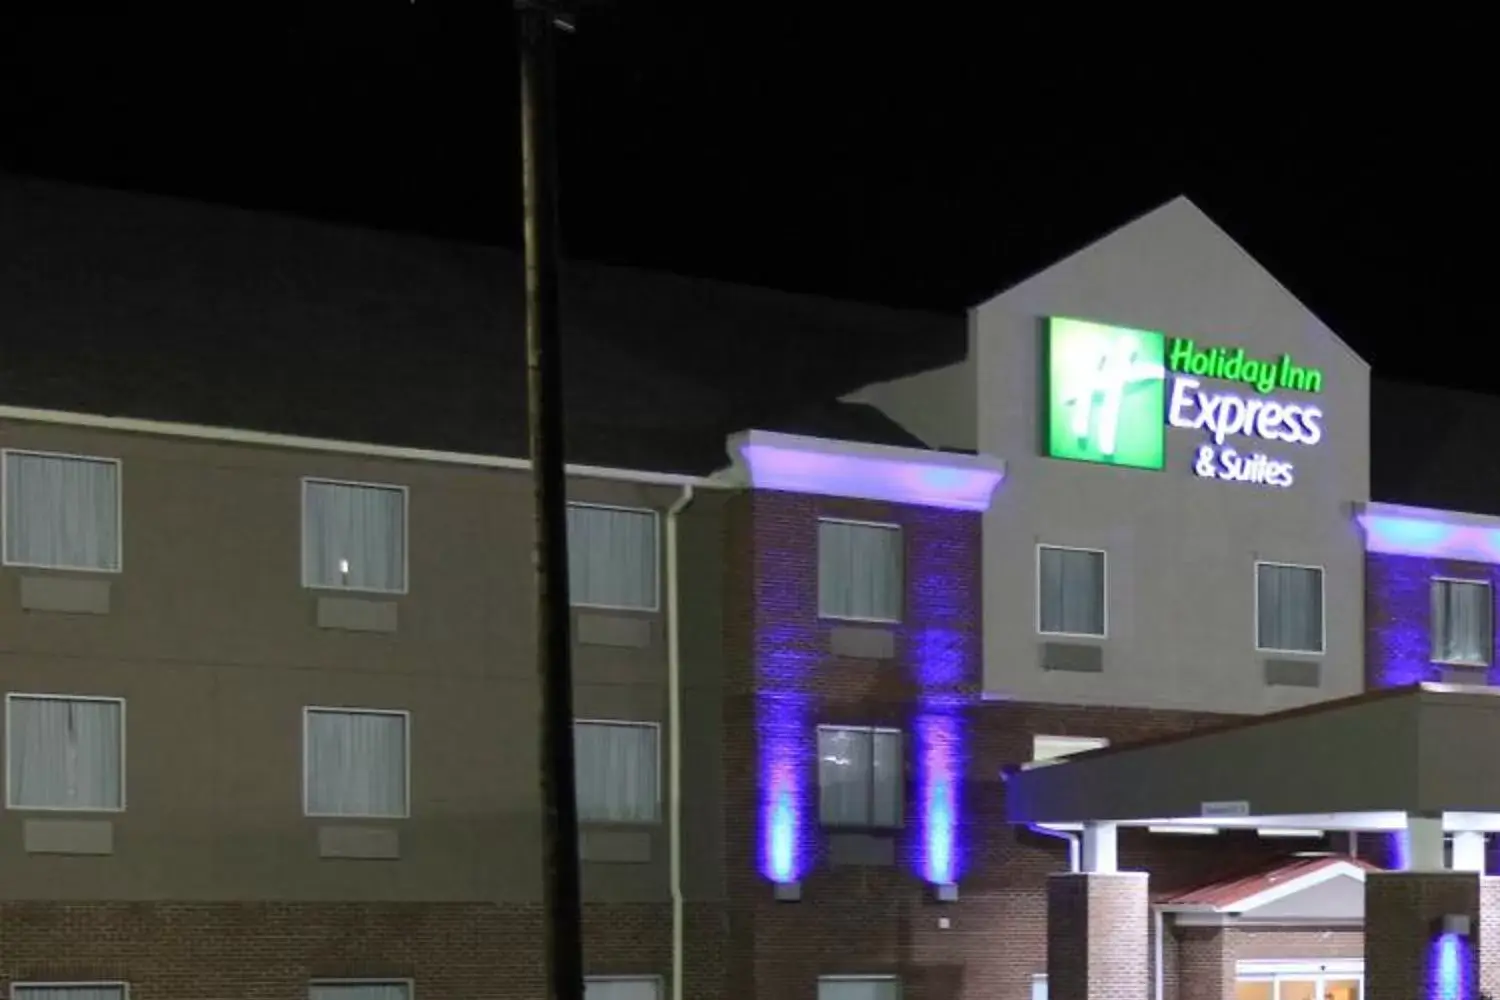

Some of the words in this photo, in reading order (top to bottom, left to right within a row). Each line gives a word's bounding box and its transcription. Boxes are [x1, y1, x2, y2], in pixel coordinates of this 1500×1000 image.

[1169, 338, 1277, 393] Holiday
[1278, 353, 1322, 392] Inn
[1169, 376, 1323, 445] Express
[1196, 447, 1216, 478] &
[1219, 449, 1294, 487] Suites
